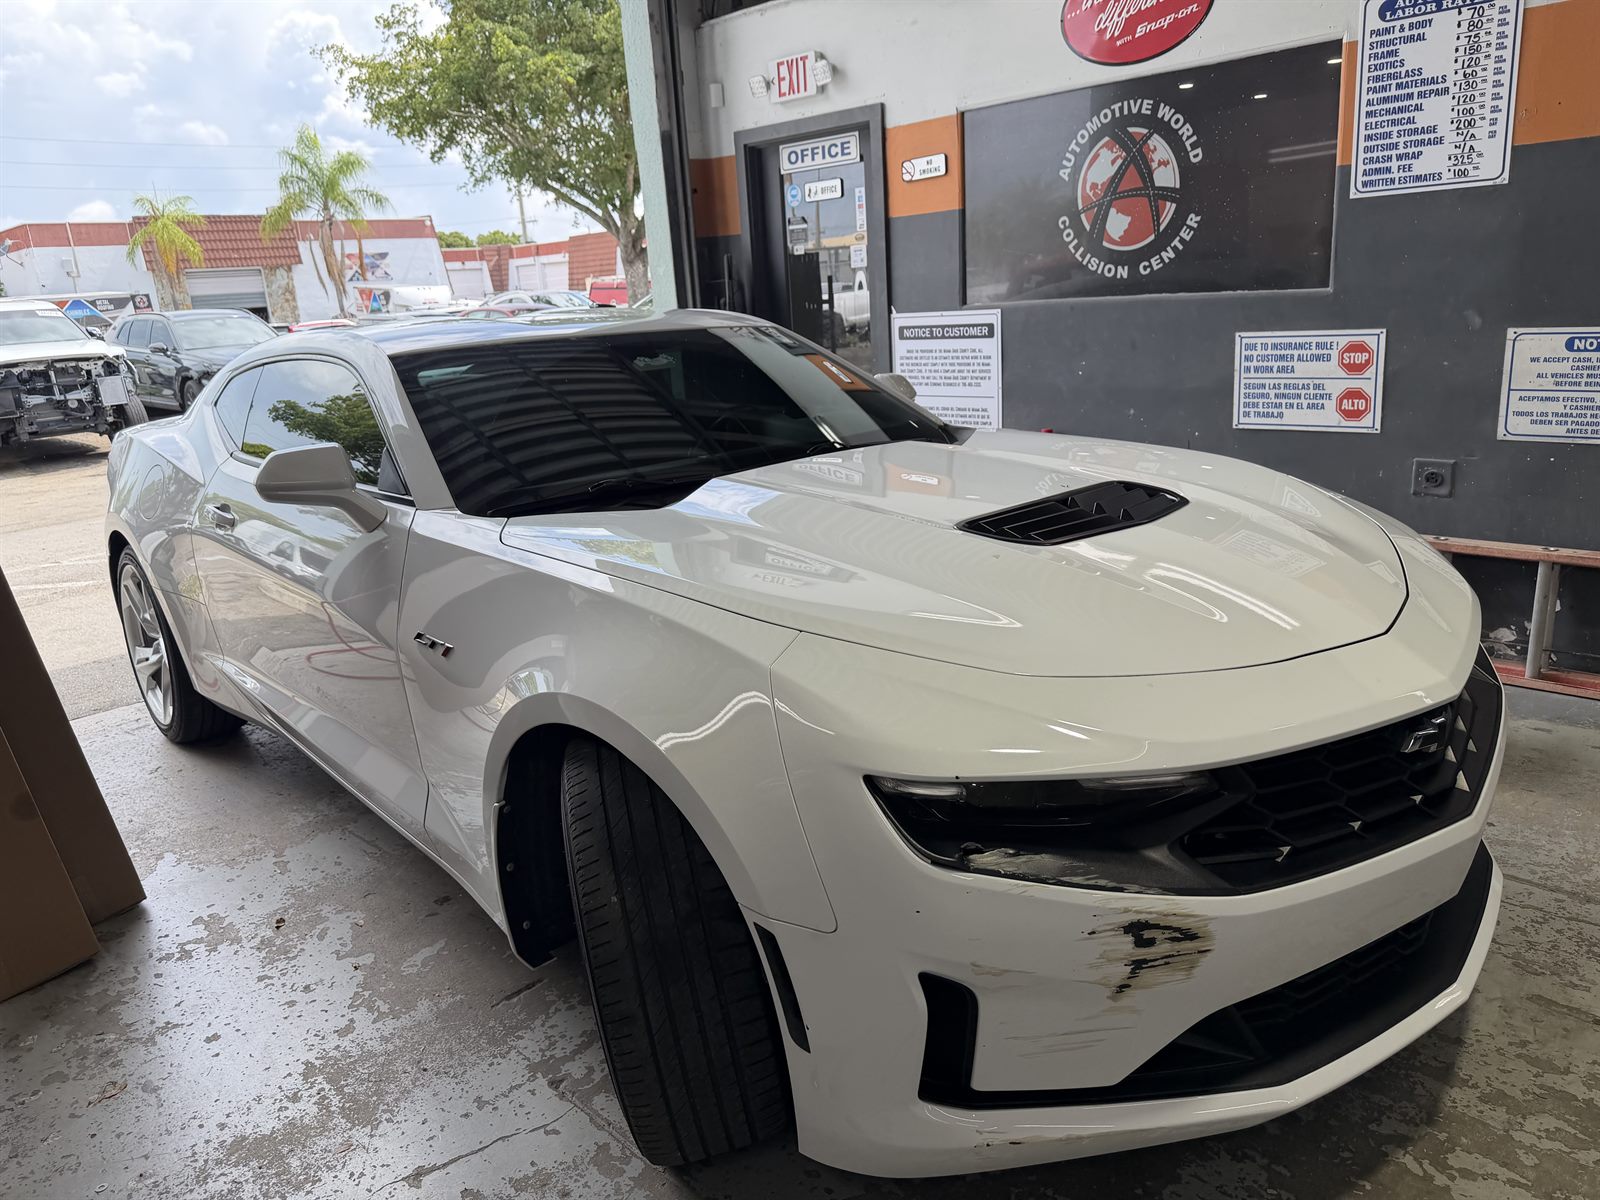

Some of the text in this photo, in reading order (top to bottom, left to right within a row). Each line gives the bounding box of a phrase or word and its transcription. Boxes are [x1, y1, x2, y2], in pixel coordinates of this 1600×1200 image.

[1385, 3, 1436, 20] LABOR
[1116, 3, 1199, 46] WITH Snap-on
[1370, 18, 1433, 38] PAINT & BODY
[1369, 32, 1427, 50] STRUCTURAL
[1368, 48, 1400, 62] FRAME
[1368, 59, 1405, 73] EXOTICS
[777, 55, 809, 97] EXIT
[1367, 67, 1423, 85] FIBERGLASS
[1367, 75, 1447, 95] PAINT MATERIALS
[1366, 87, 1449, 107] ALUMINUM REPAIR
[1365, 103, 1424, 119] MECHANICAL
[1365, 116, 1417, 131] ELECTRICAL
[1059, 99, 1203, 182] AUTOMOTIVE WORLD
[1364, 125, 1438, 142] INSIDE STORAGE
[1457, 130, 1476, 141] N/A
[1364, 136, 1445, 154] OUTSIDE STORAGE
[1455, 143, 1475, 153] N/A
[787, 141, 851, 165] OFFICE
[1363, 151, 1423, 165] CRASH WRAP
[919, 166, 940, 175] SMOKING
[1362, 163, 1413, 177] ADMIN. FEE
[1361, 172, 1443, 189] WRITTEN ESTIMATES
[821, 184, 838, 194] OFFICE
[1058, 213, 1201, 279] COLLISION CENTER
[904, 326, 988, 338] NOTICE TO CUSTOMER
[1244, 342, 1258, 351] DUE
[1260, 342, 1269, 351] TO
[1271, 342, 1313, 351] INSURANCE
[1574, 339, 1600, 350] NO
[1244, 354, 1331, 362] NO CUSTOMER ALLOWED
[1343, 353, 1369, 364] STOP
[1244, 365, 1295, 374] IN WORK AREA
[1313, 383, 1325, 391] DEL
[1243, 392, 1332, 401] SEGURO, NINGUN CLIENTE
[1243, 401, 1260, 409] DEBE
[1285, 402, 1294, 410] EN
[1296, 402, 1304, 410] EL
[1306, 402, 1325, 410] AREA
[1341, 399, 1366, 410] ALTO
[1253, 411, 1284, 419] TRABAJO
